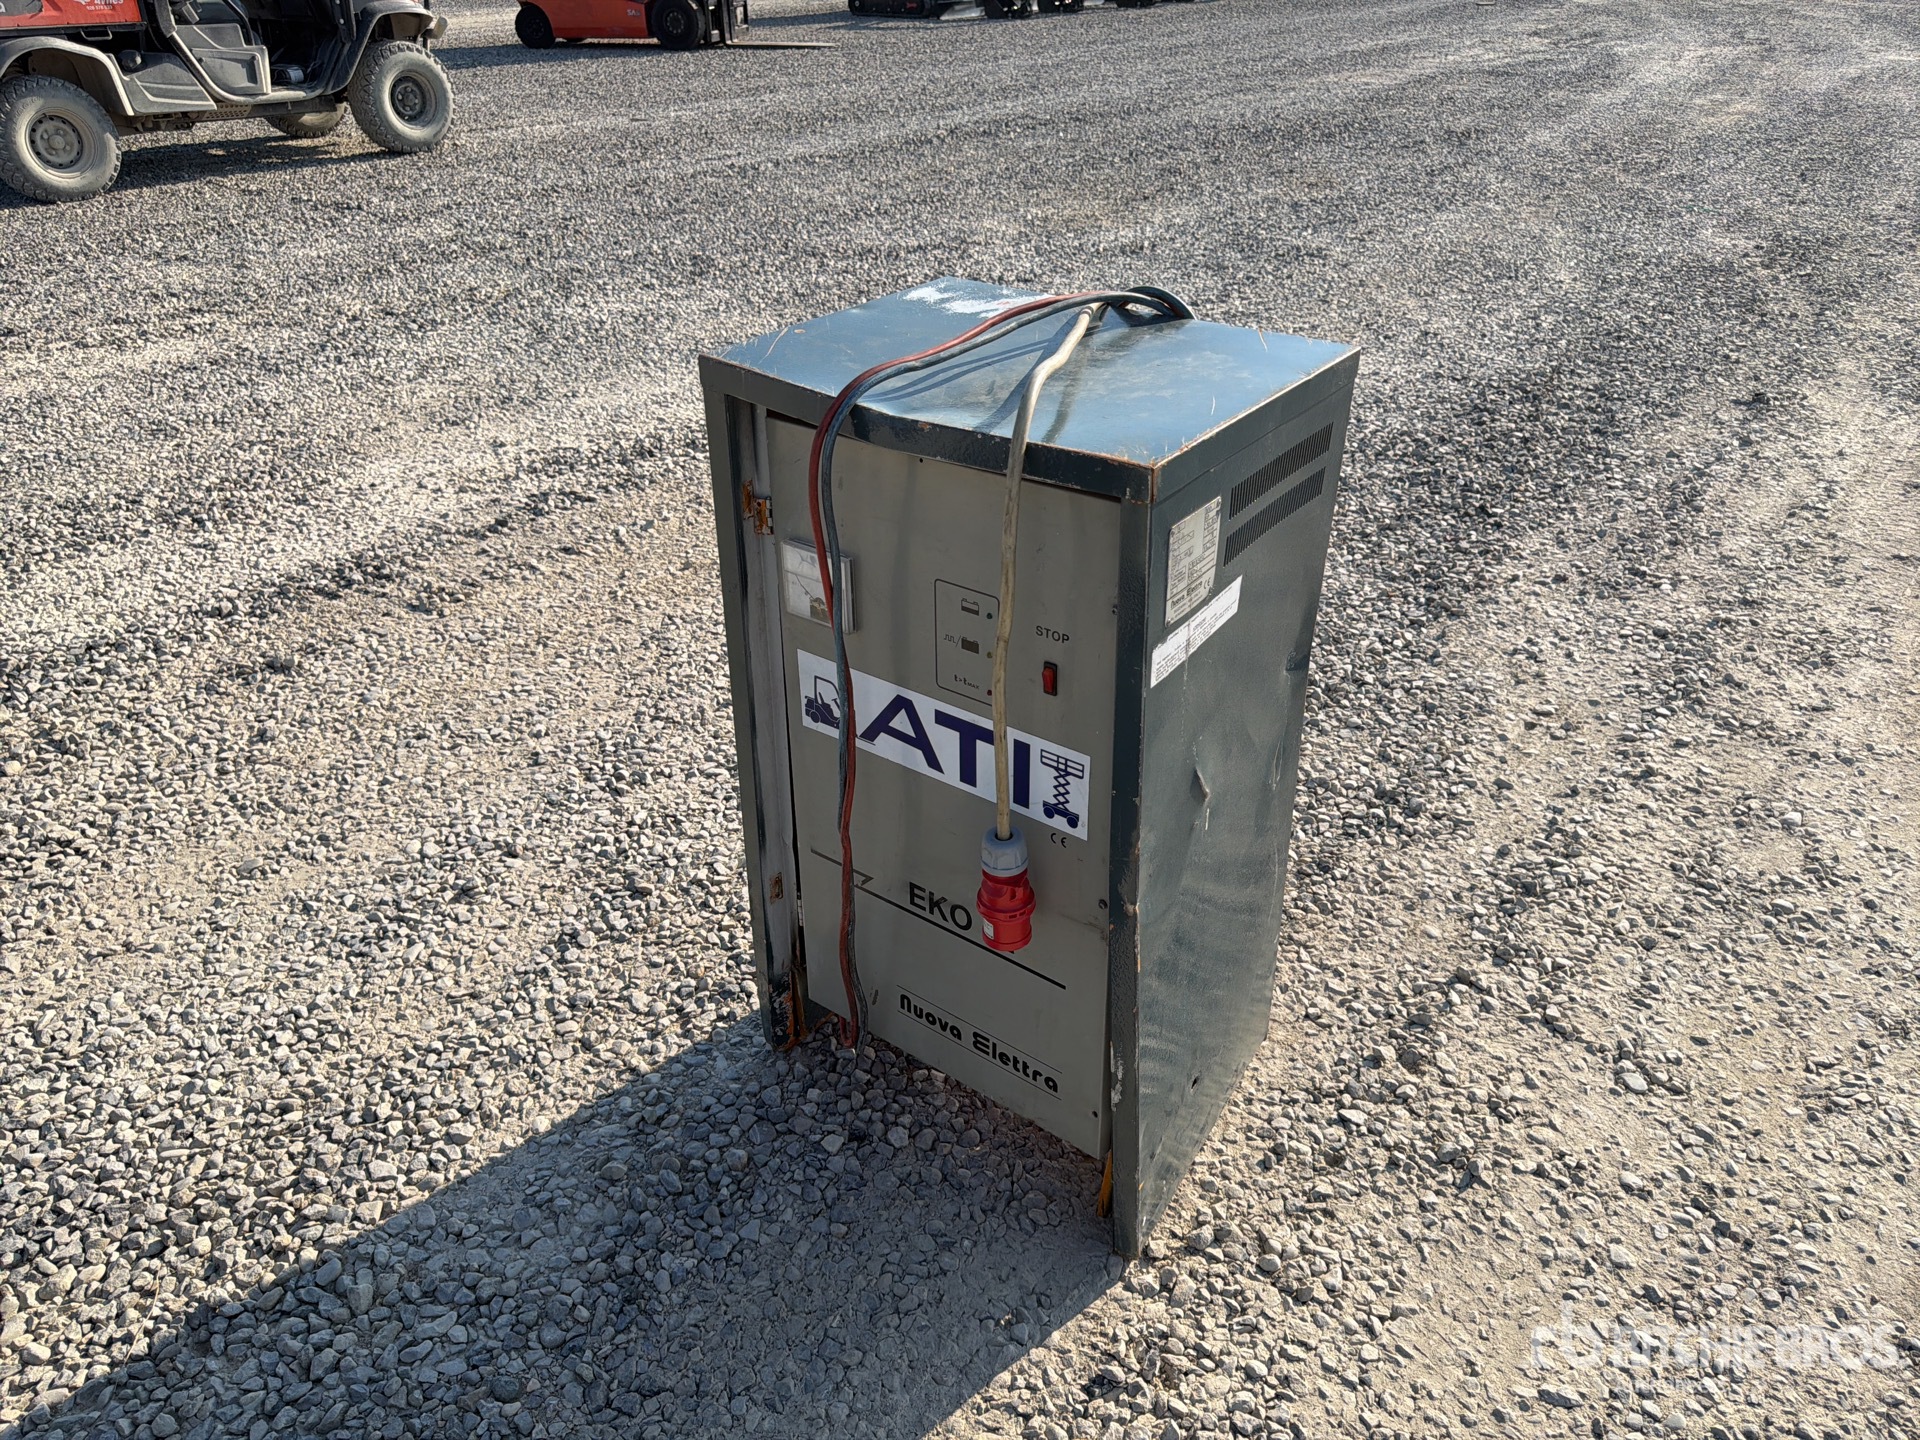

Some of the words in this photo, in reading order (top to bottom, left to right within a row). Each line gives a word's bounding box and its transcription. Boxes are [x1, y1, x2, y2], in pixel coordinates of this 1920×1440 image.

[1035, 625, 1070, 644] STOP
[859, 694, 1031, 810] ATI
[909, 882, 973, 931] EKO
[899, 993, 962, 1041] Nuova
[972, 1030, 1059, 1094] Elettra
